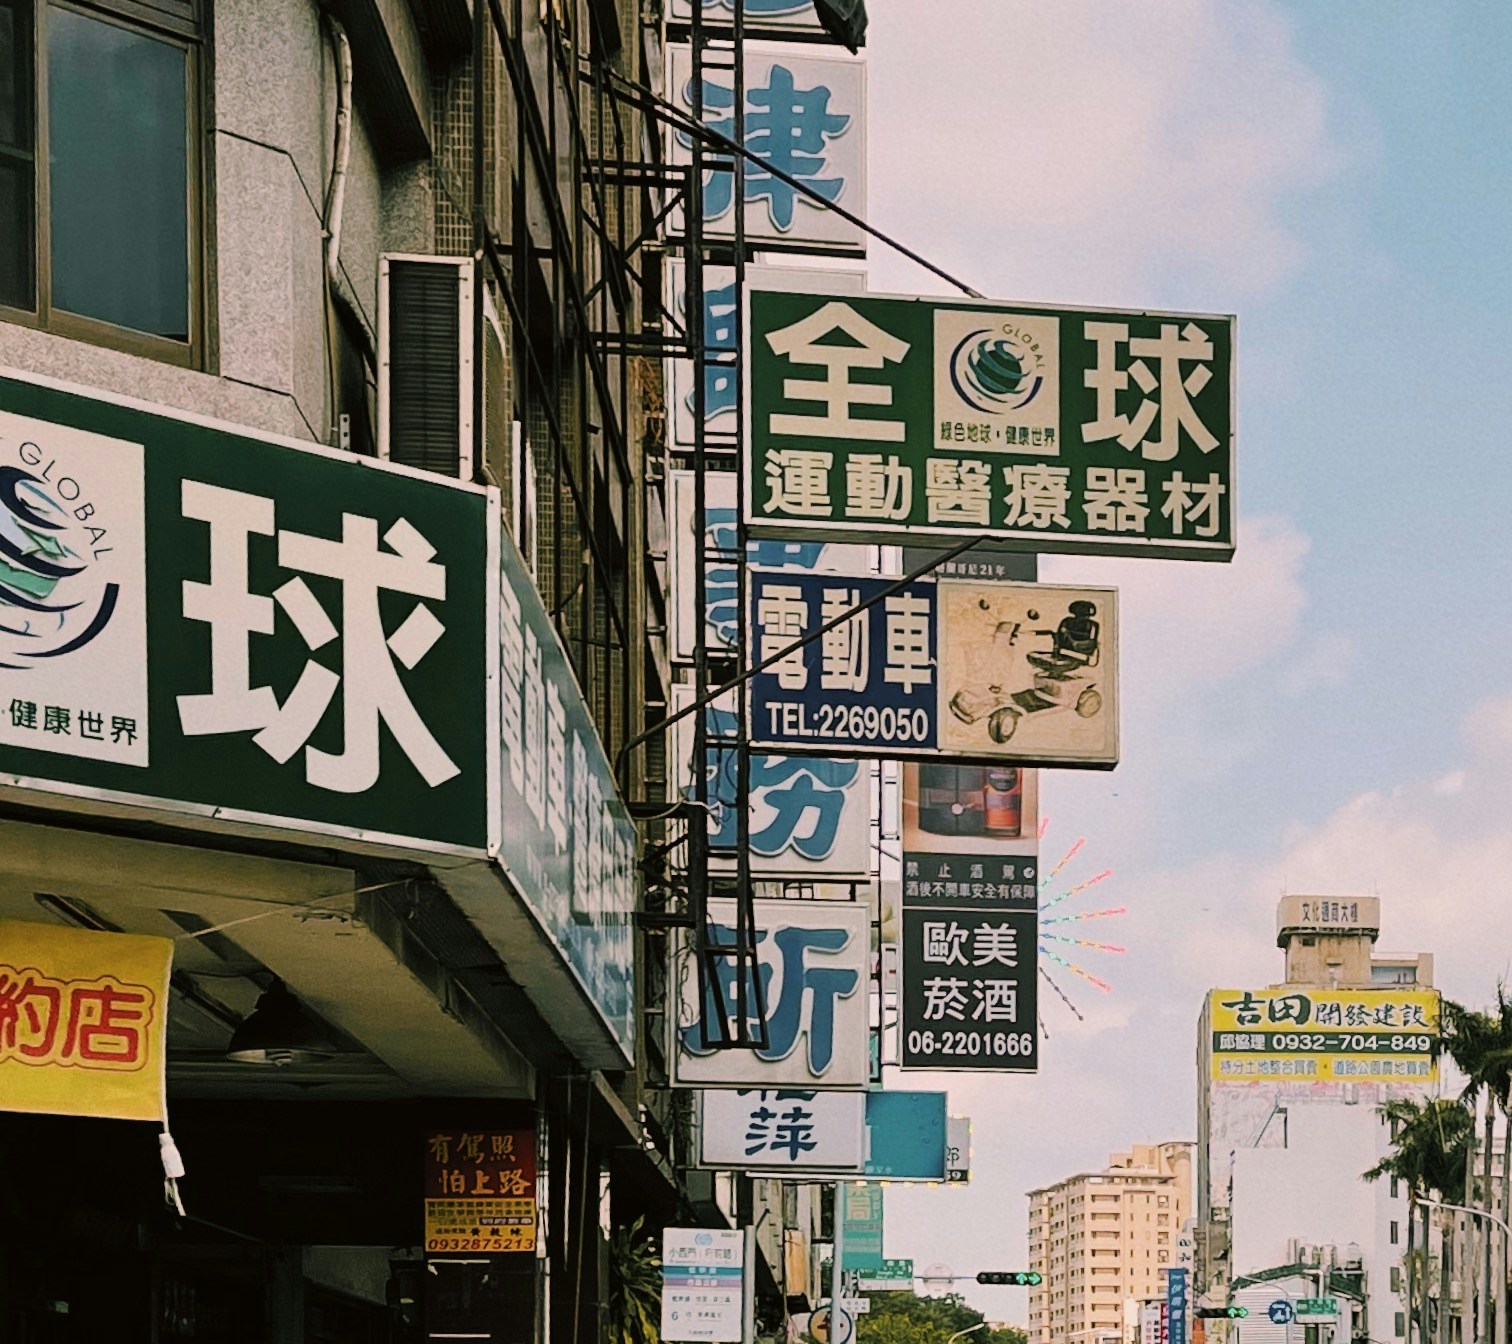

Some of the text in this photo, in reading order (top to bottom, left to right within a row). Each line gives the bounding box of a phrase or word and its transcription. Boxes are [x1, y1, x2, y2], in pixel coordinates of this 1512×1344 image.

[1002, 323, 1047, 370] GLOBAL
[765, 302, 1221, 463] 全 球
[19, 441, 117, 562] GLOBAL
[763, 448, 1226, 537] 運動醫療器材
[176, 478, 461, 793] 球
[758, 584, 934, 694] 電動車
[9, 698, 139, 748] 健康世界
[765, 701, 929, 742] TEL:2269050
[922, 921, 1018, 968] 歐美
[922, 976, 1018, 1023] 菸酒
[907, 1030, 1033, 1057] 06-2201666
[1272, 1034, 1431, 1052] 0932-704-849
